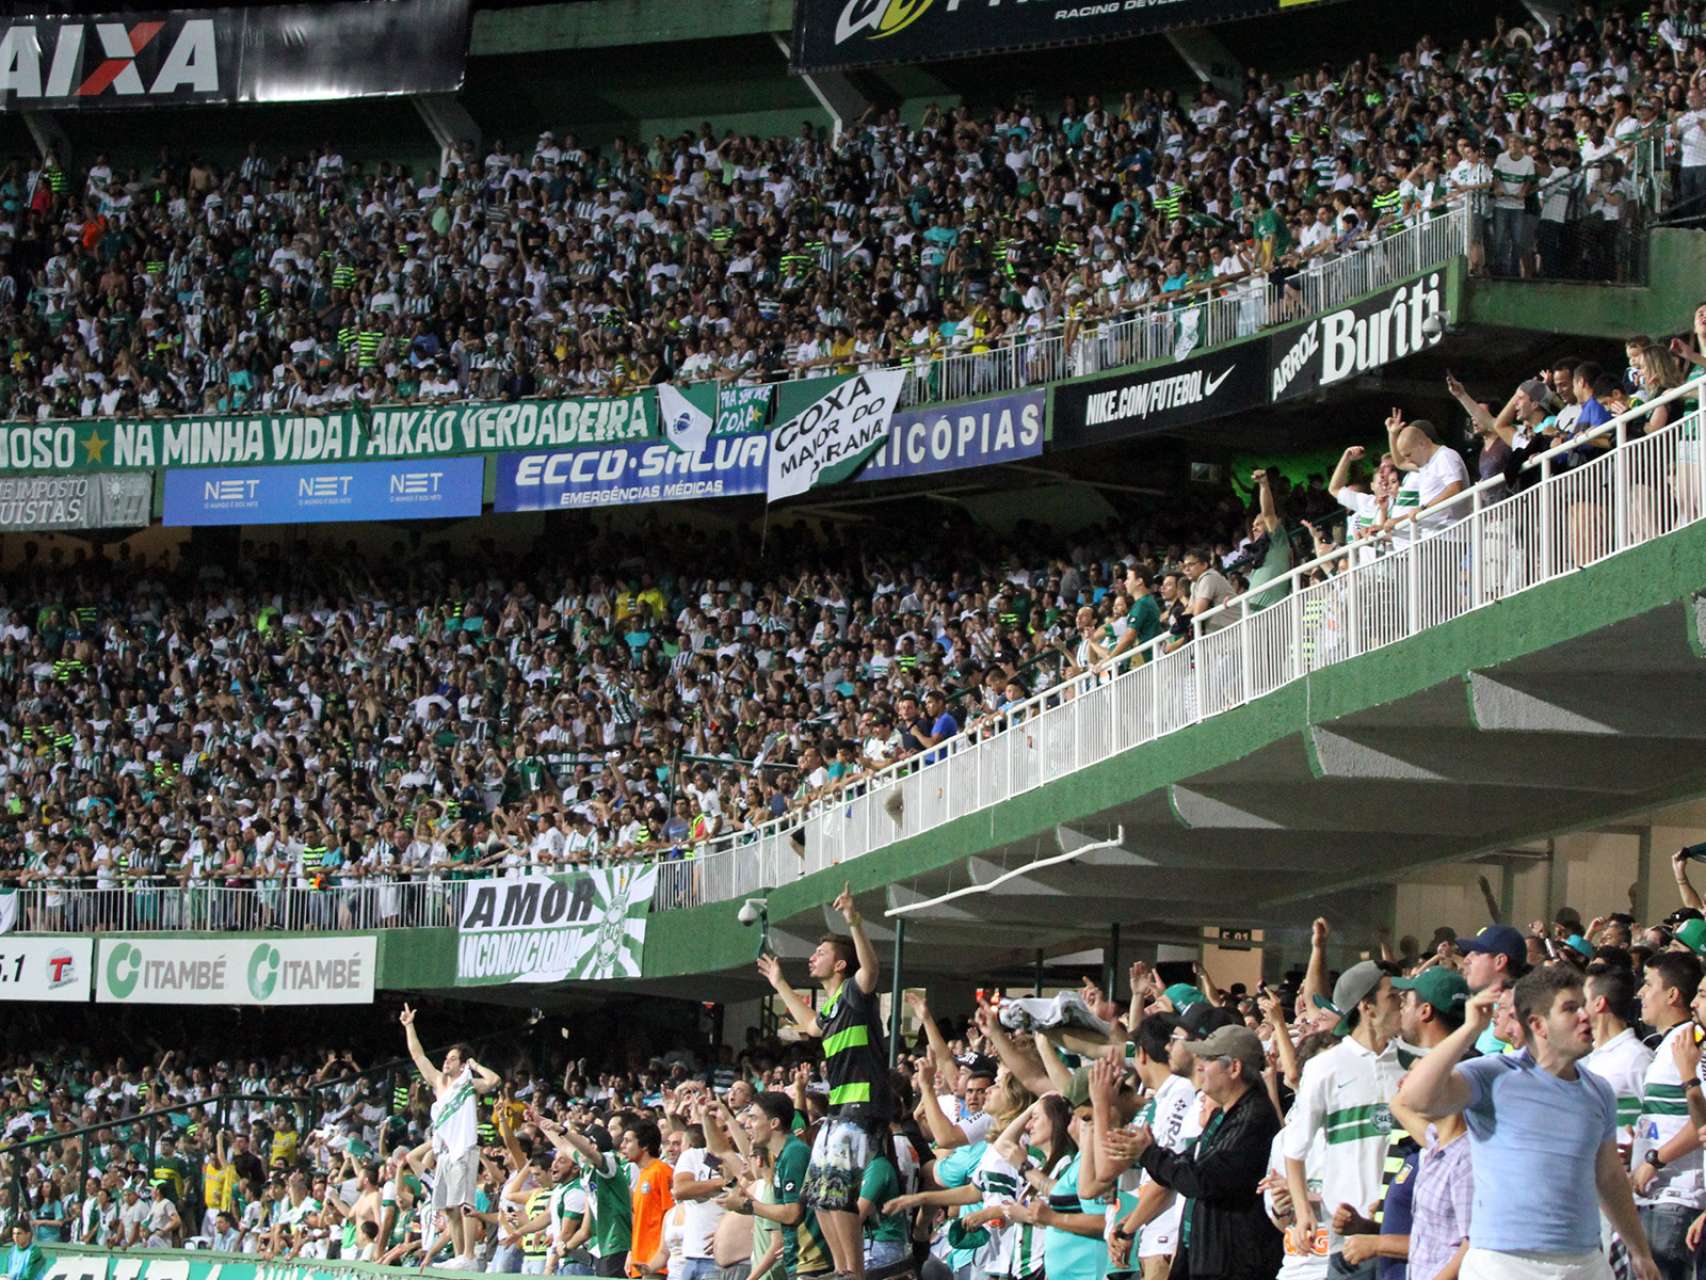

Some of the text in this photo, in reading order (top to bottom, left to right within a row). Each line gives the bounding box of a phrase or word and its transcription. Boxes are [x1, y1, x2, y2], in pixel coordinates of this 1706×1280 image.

[1054, 2, 1120, 20] RACING
[1272, 320, 1319, 402] ARROZ
[775, 376, 871, 452] COXA
[114, 424, 155, 465] NA
[162, 420, 264, 465] MINHA
[271, 415, 342, 460] VIDA
[461, 396, 649, 448] VERDADEIRA
[781, 397, 886, 479] MAIOR DO
[16, 480, 88, 499] IMPOSTO
[204, 480, 260, 500] NET
[298, 476, 353, 497] NET
[390, 472, 443, 494] NET
[560, 479, 723, 505] EMERGÊNCIAS MÉDICAS
[463, 878, 597, 929] AMOR
[0, 953, 26, 982] .1
[144, 954, 227, 990] ITAMBÉ
[282, 953, 362, 989] ITAMBÉ
